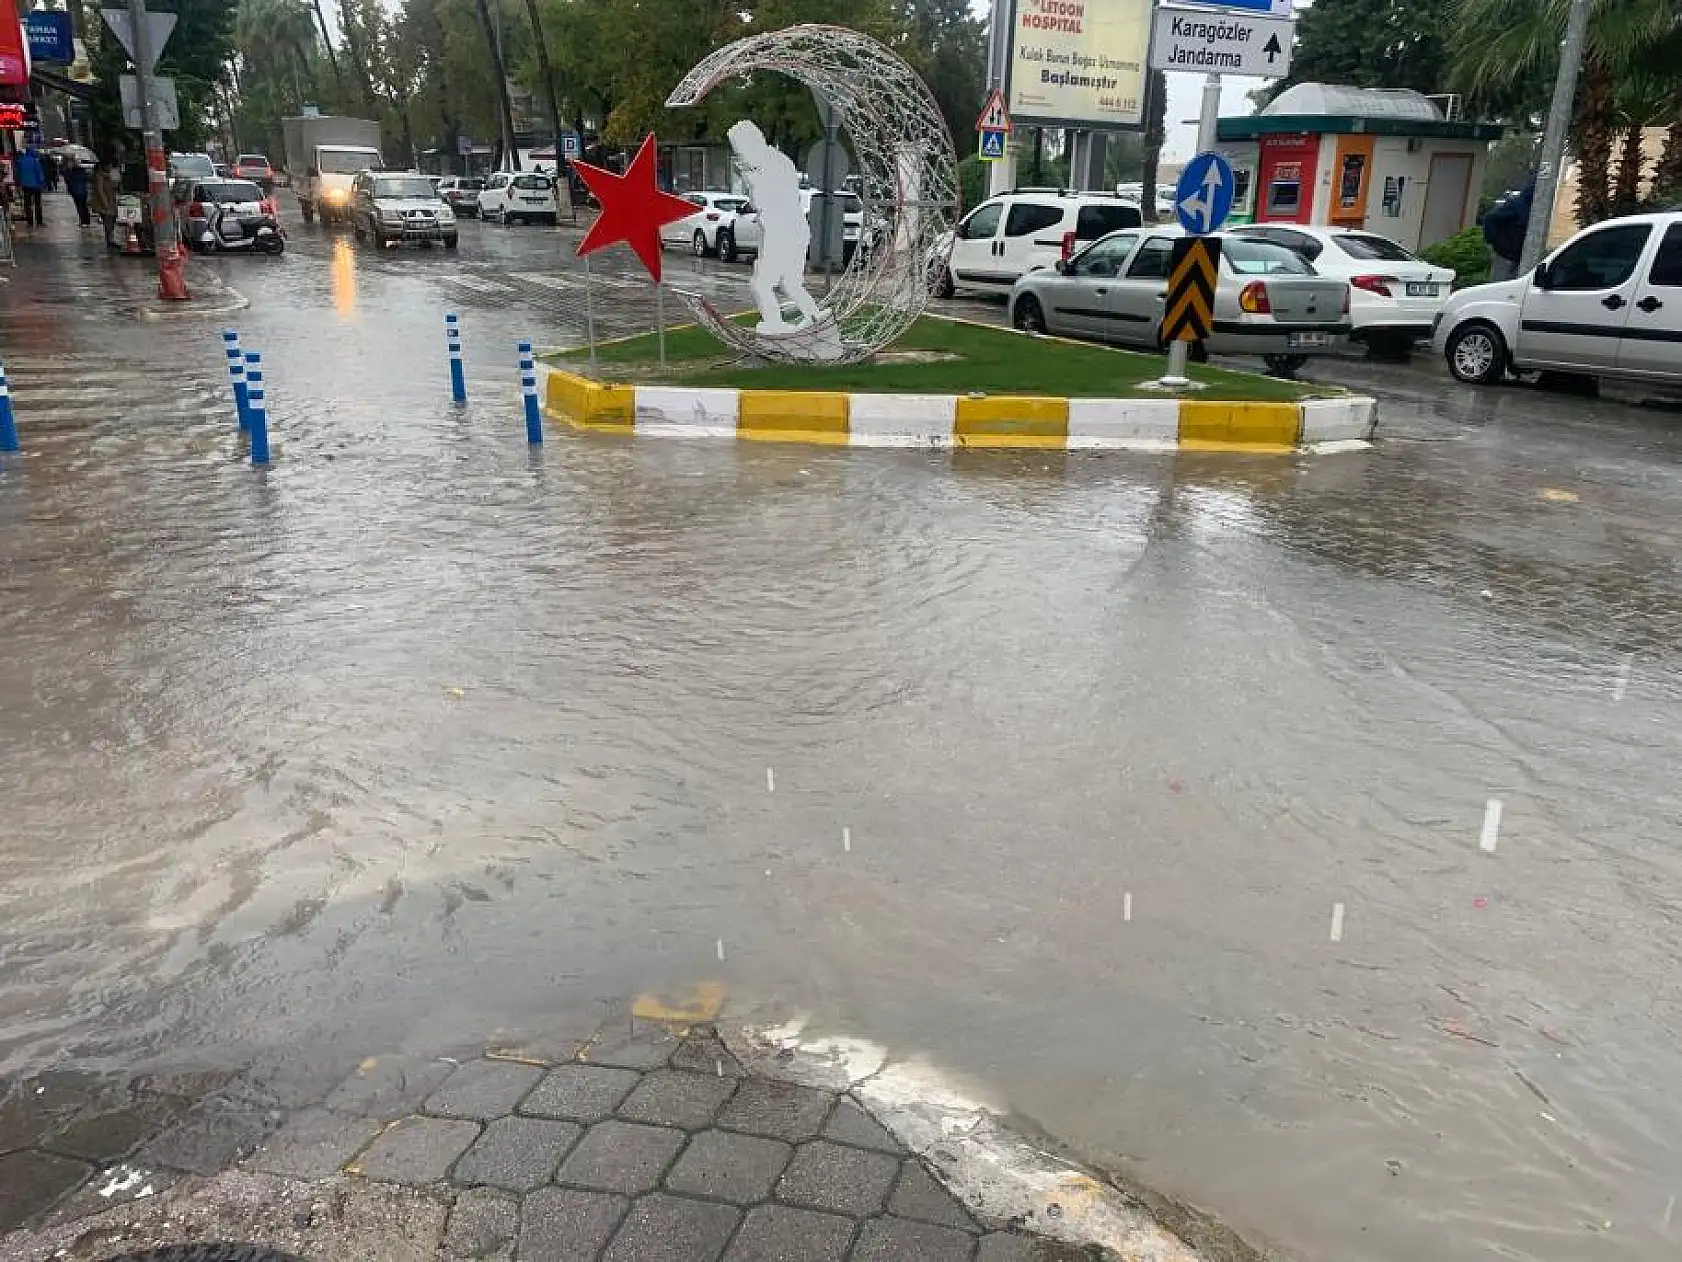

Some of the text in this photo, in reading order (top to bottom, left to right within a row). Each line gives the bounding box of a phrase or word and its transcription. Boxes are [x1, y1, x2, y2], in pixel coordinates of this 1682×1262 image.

[1022, 14, 1083, 34] HOSPITAL
[1171, 16, 1253, 43] Karagözler
[1168, 43, 1242, 67] Jandarma
